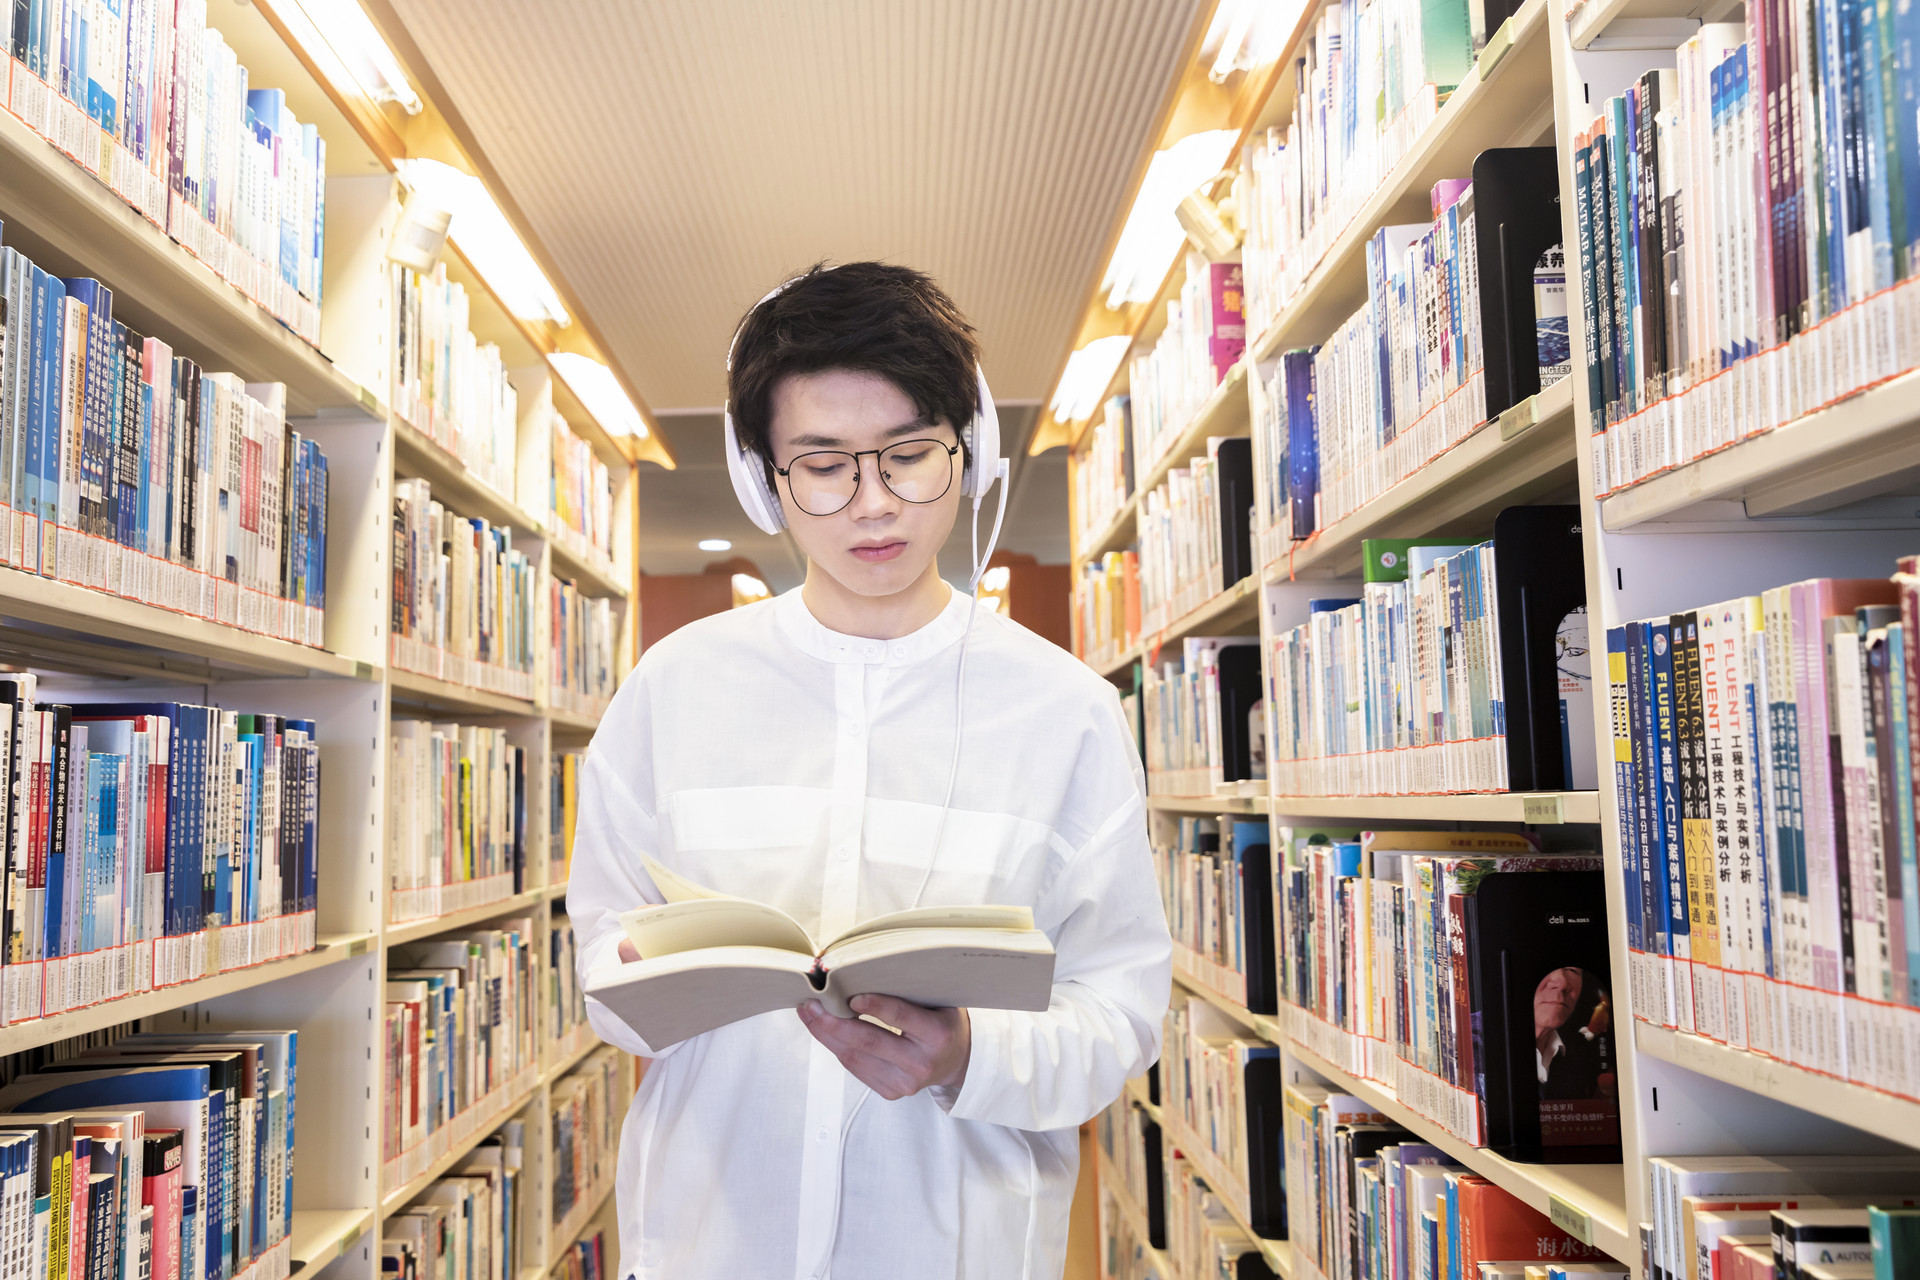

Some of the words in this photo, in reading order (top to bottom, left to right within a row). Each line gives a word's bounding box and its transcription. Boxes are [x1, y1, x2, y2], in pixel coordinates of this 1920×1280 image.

[1578, 187, 1589, 251] MATLAB
[1642, 645, 1651, 702] FLUENT
[1656, 672, 1672, 742] FLUENT
[1673, 651, 1688, 715] FLUENT
[1687, 647, 1702, 714] FLUENT
[1704, 643, 1720, 733] FLUENT
[1724, 639, 1741, 730] FLUENT
[1611, 684, 1621, 738] Fluent
[1619, 684, 1629, 738] Fluent
[1677, 719, 1689, 740] 6.3
[1691, 716, 1704, 738] 6.3
[55, 746, 67, 852] 聚合物纳米复合材料
[1679, 741, 1695, 818] 流场分析
[1693, 740, 1709, 818] 流场分析
[1711, 738, 1731, 883] 工程技术与实例分析
[1731, 735, 1752, 884] 工程技术与实例分析
[1661, 747, 1683, 920] 基础入门与案例精通
[1686, 821, 1701, 924] 从入门到精通
[1700, 821, 1717, 926] 从入门到精通
[1549, 915, 1564, 924] deli
